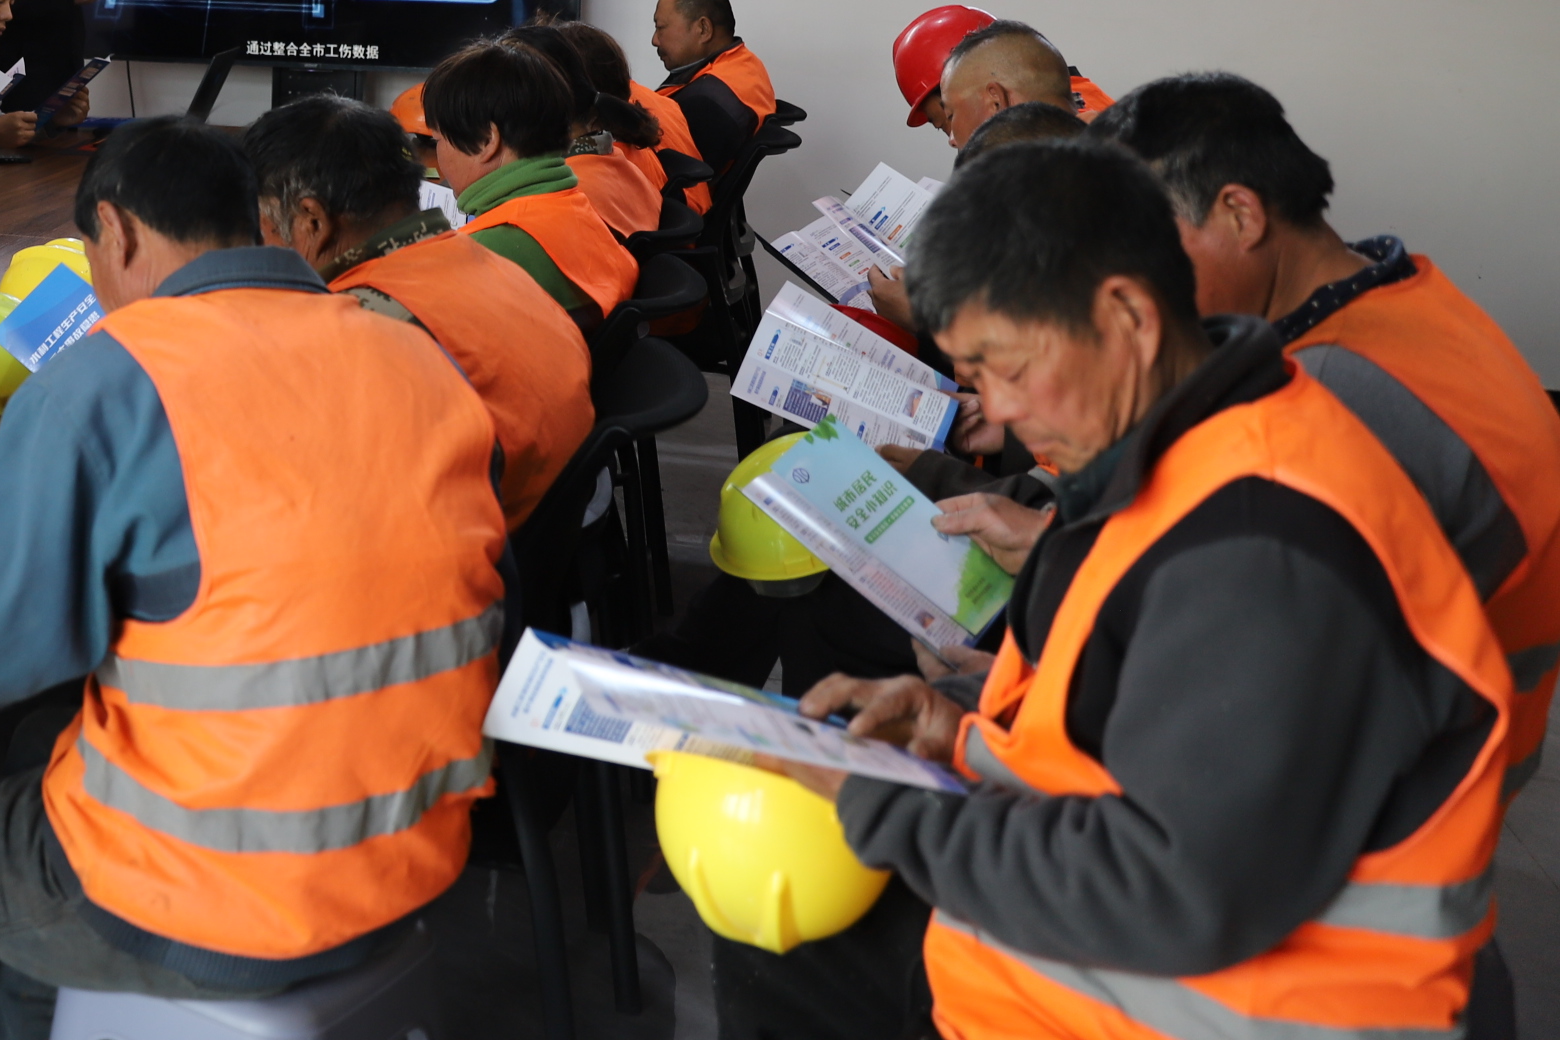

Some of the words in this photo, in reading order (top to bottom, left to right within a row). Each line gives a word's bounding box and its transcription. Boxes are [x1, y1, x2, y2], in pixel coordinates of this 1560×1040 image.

[246, 40, 379, 60] 通过整合全市工伤数据
[29, 293, 96, 364] 水利工程生产安全
[49, 310, 100, 361] 事故隐患
[833, 469, 877, 512] 城市居民
[845, 479, 898, 530] 安全小知识
